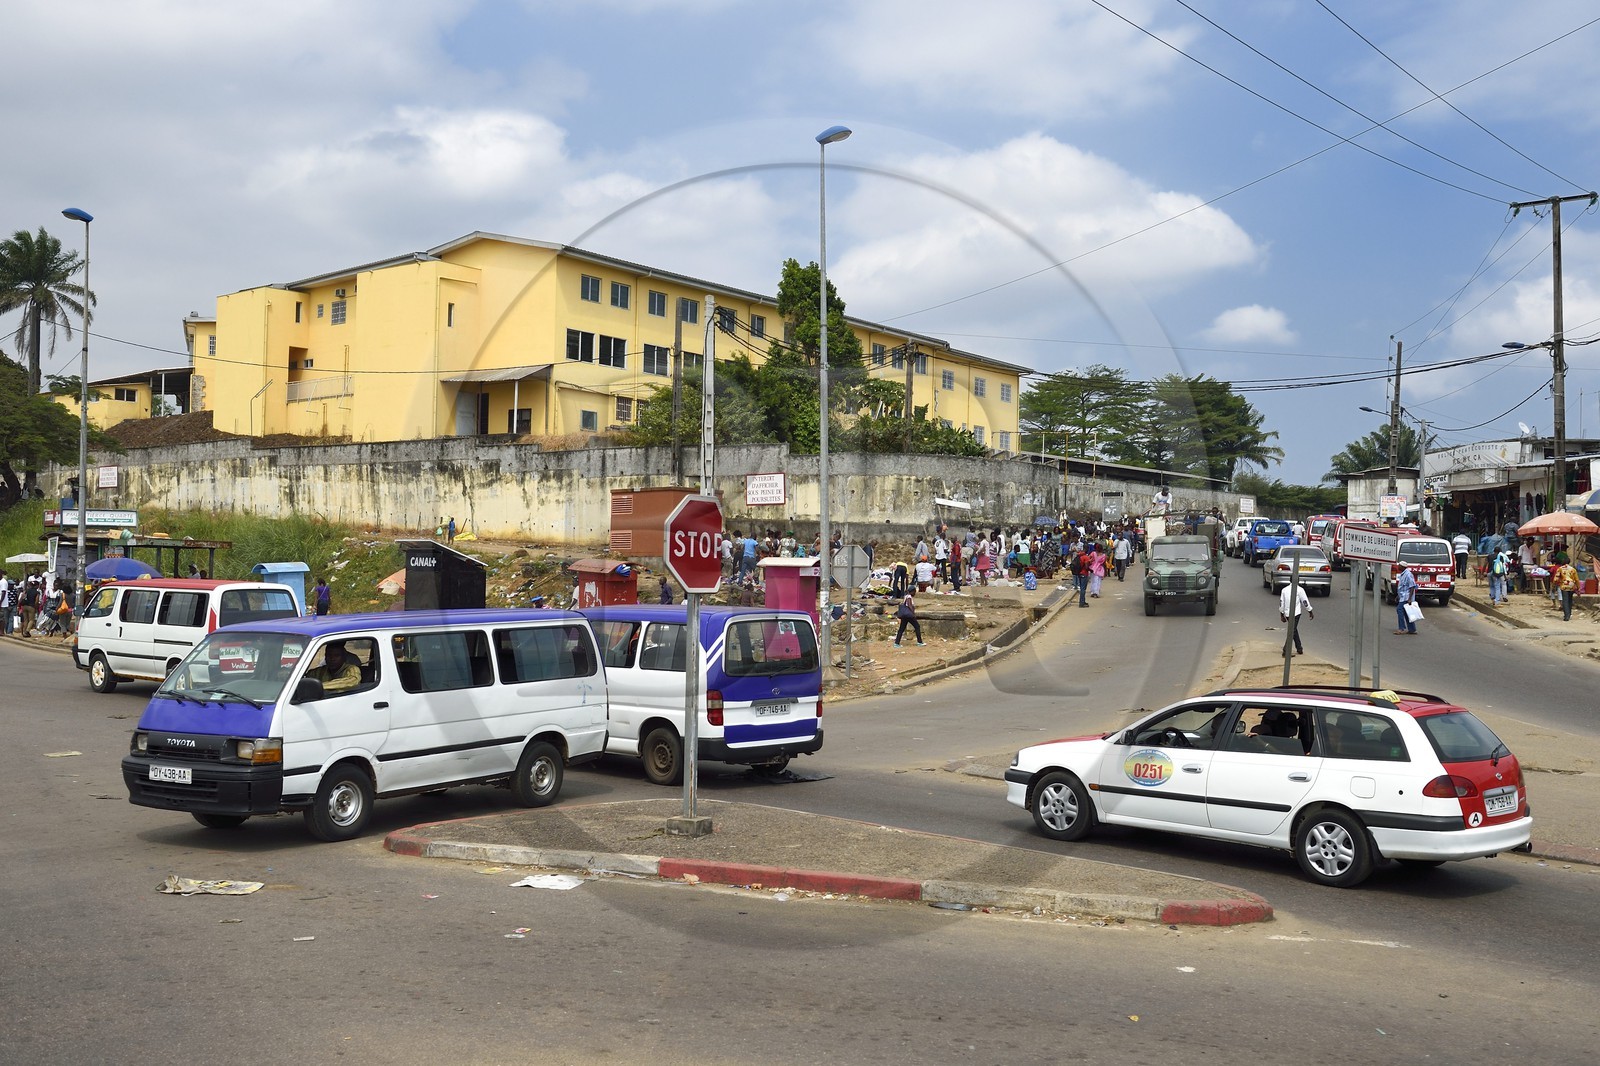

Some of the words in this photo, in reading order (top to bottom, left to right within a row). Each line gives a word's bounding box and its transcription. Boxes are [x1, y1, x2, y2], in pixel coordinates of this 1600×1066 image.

[1345, 532, 1367, 543] COMMUNE
[673, 530, 722, 559] STOP
[410, 556, 437, 567] CANAL+
[166, 738, 196, 747] TOYOTA
[1133, 762, 1163, 780] 0251
[1471, 813, 1480, 824] A
